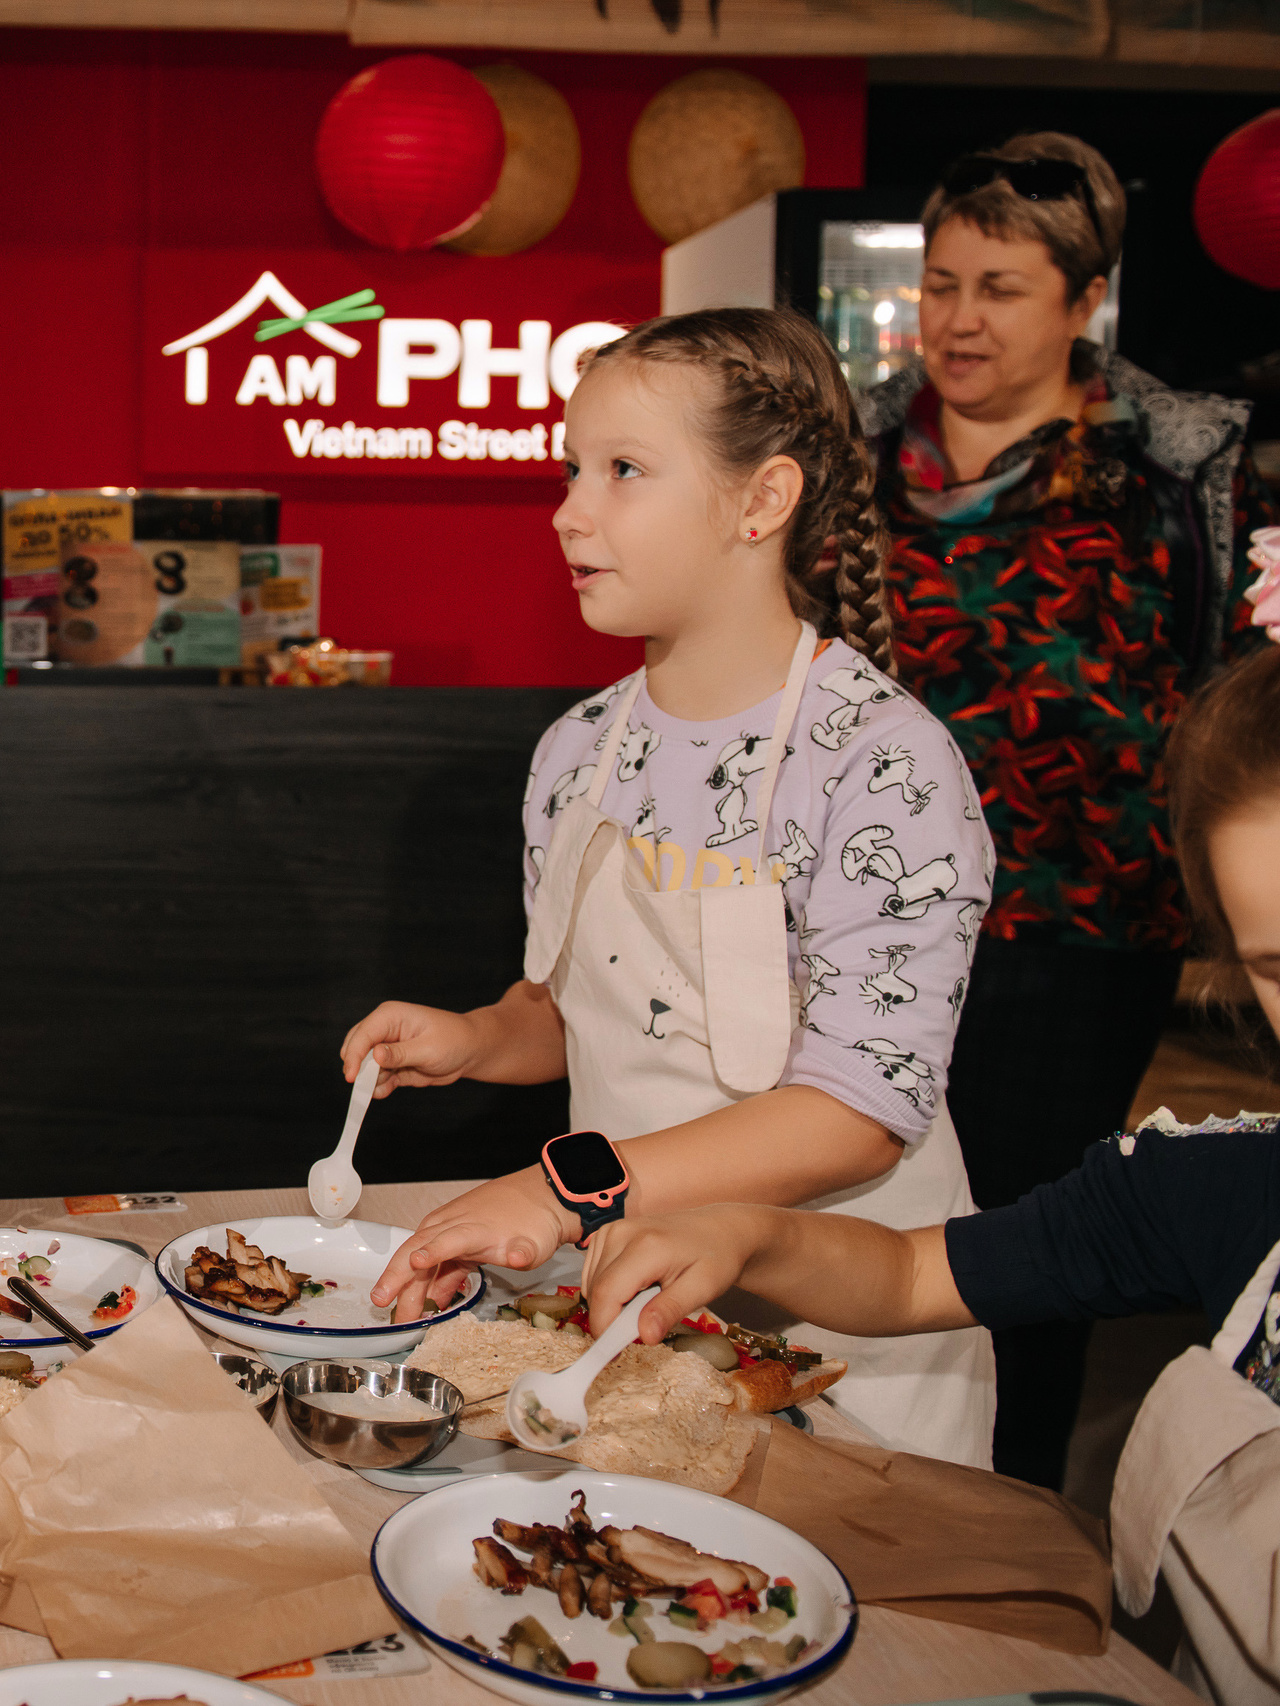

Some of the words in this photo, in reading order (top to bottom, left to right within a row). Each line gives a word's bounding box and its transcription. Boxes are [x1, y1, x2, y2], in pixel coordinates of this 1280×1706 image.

[235, 354, 337, 406] AM
[283, 418, 433, 459] Vietnam
[437, 419, 549, 461] Street
[323, 1633, 405, 1656] 23
